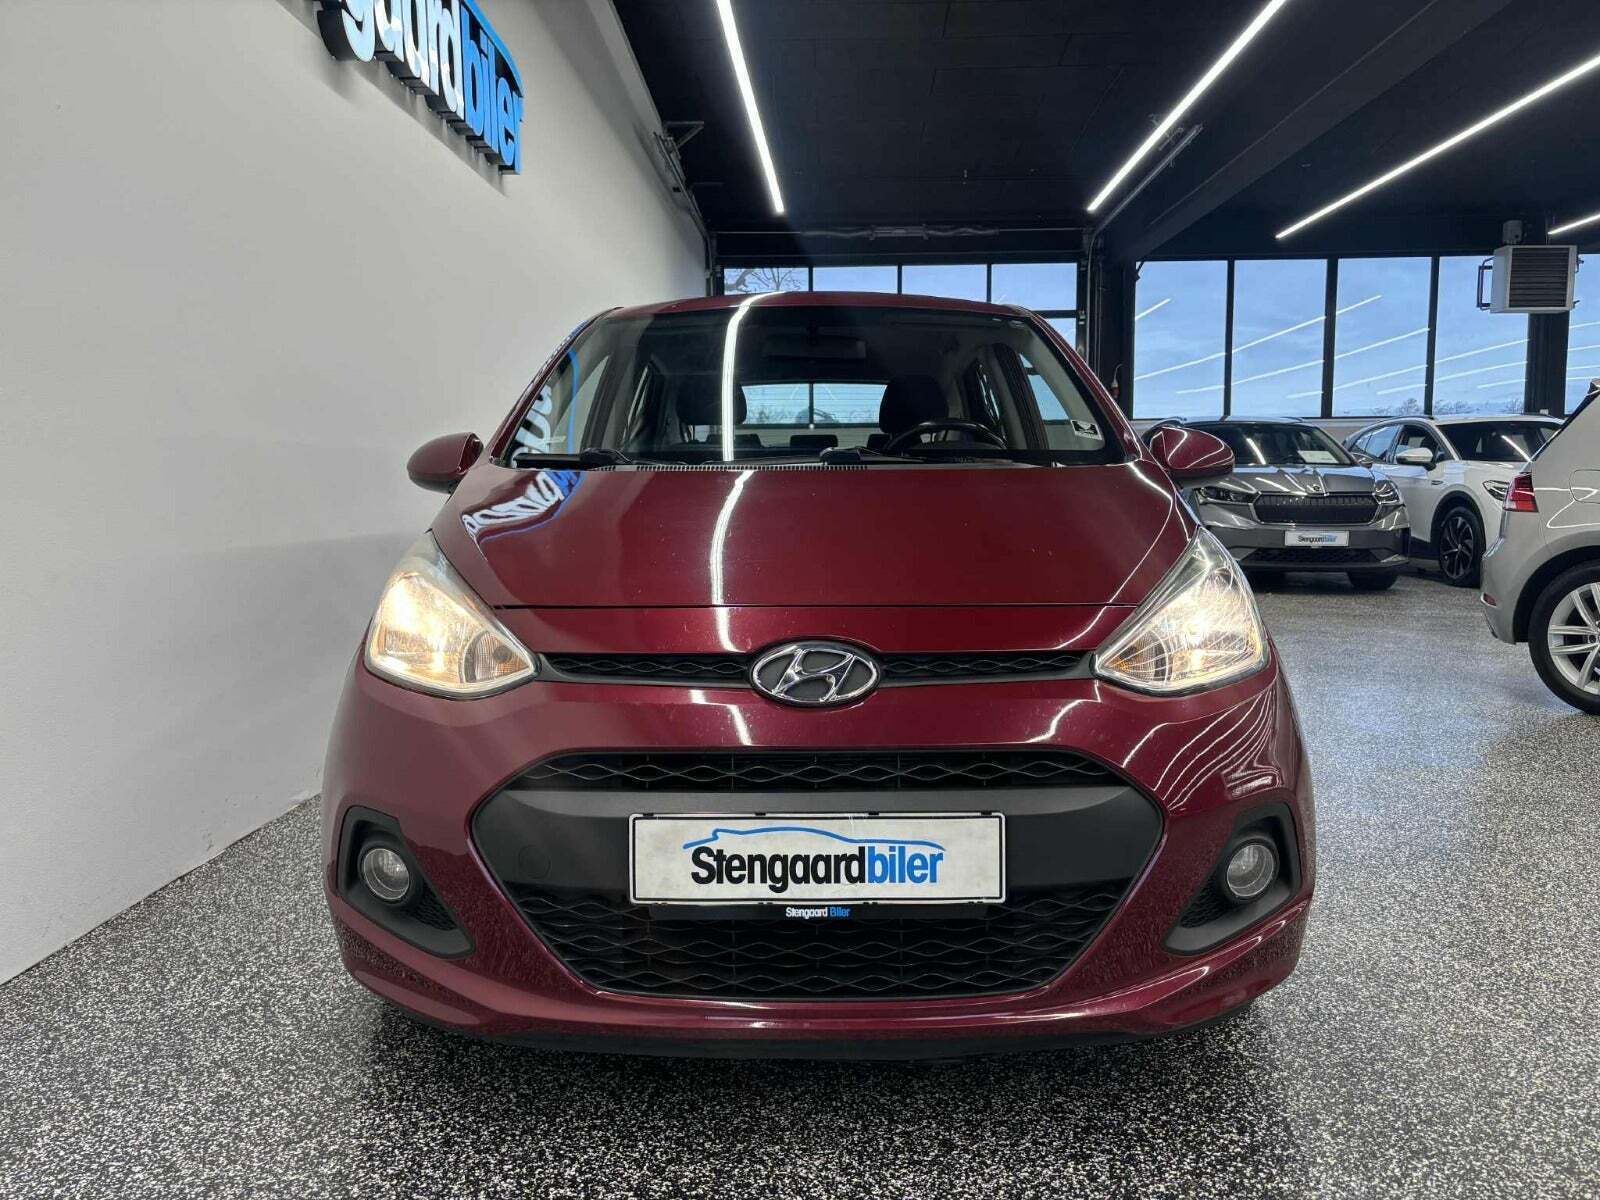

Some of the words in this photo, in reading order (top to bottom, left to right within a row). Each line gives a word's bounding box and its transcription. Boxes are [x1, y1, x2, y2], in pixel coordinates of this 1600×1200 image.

[691, 846, 944, 893] Stengaardbiler
[785, 906, 828, 919] Stengaard
[830, 906, 850, 917] Biler
